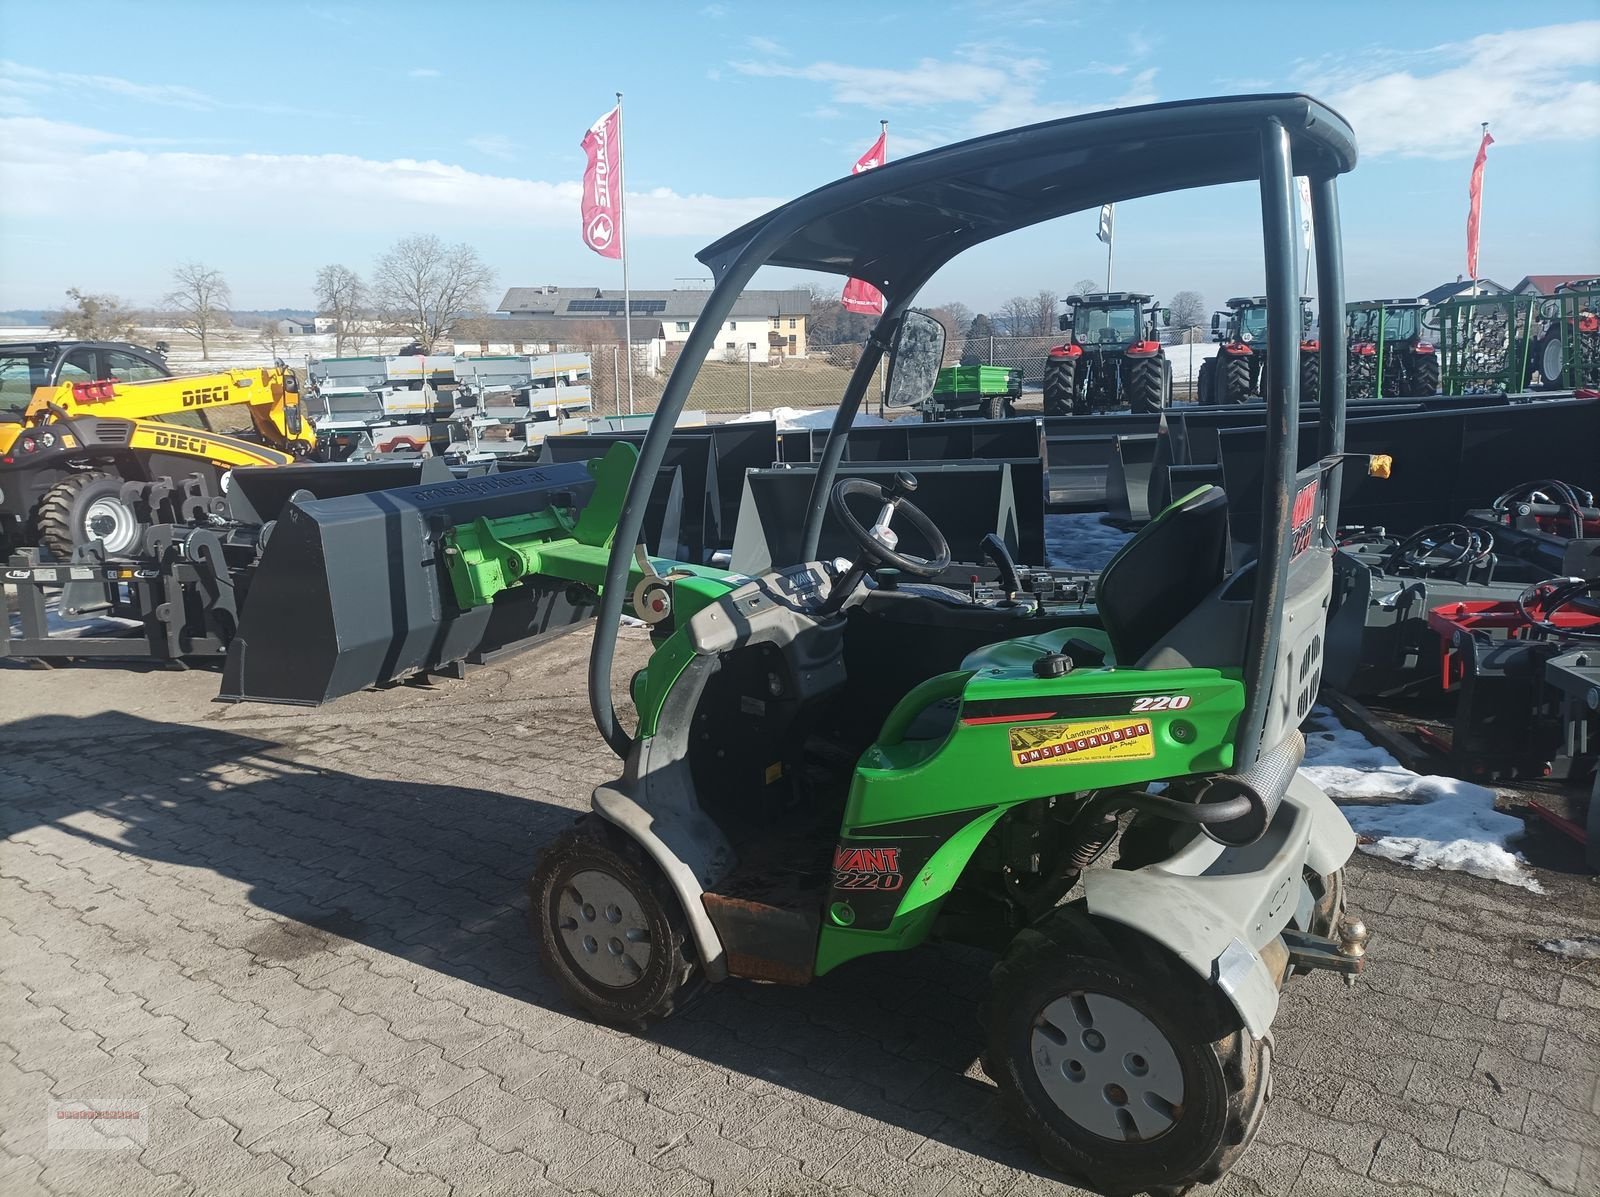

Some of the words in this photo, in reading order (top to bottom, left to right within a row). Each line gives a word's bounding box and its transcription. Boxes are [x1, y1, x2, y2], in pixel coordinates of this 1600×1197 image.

[182, 386, 229, 407] DIECI
[155, 432, 207, 454] DIECI
[1131, 696, 1191, 713] 220
[1065, 723, 1111, 740] Landtechnik
[1020, 725, 1147, 762] AMSELGRUBER
[833, 846, 900, 873] VANT
[834, 873, 903, 891] 220
